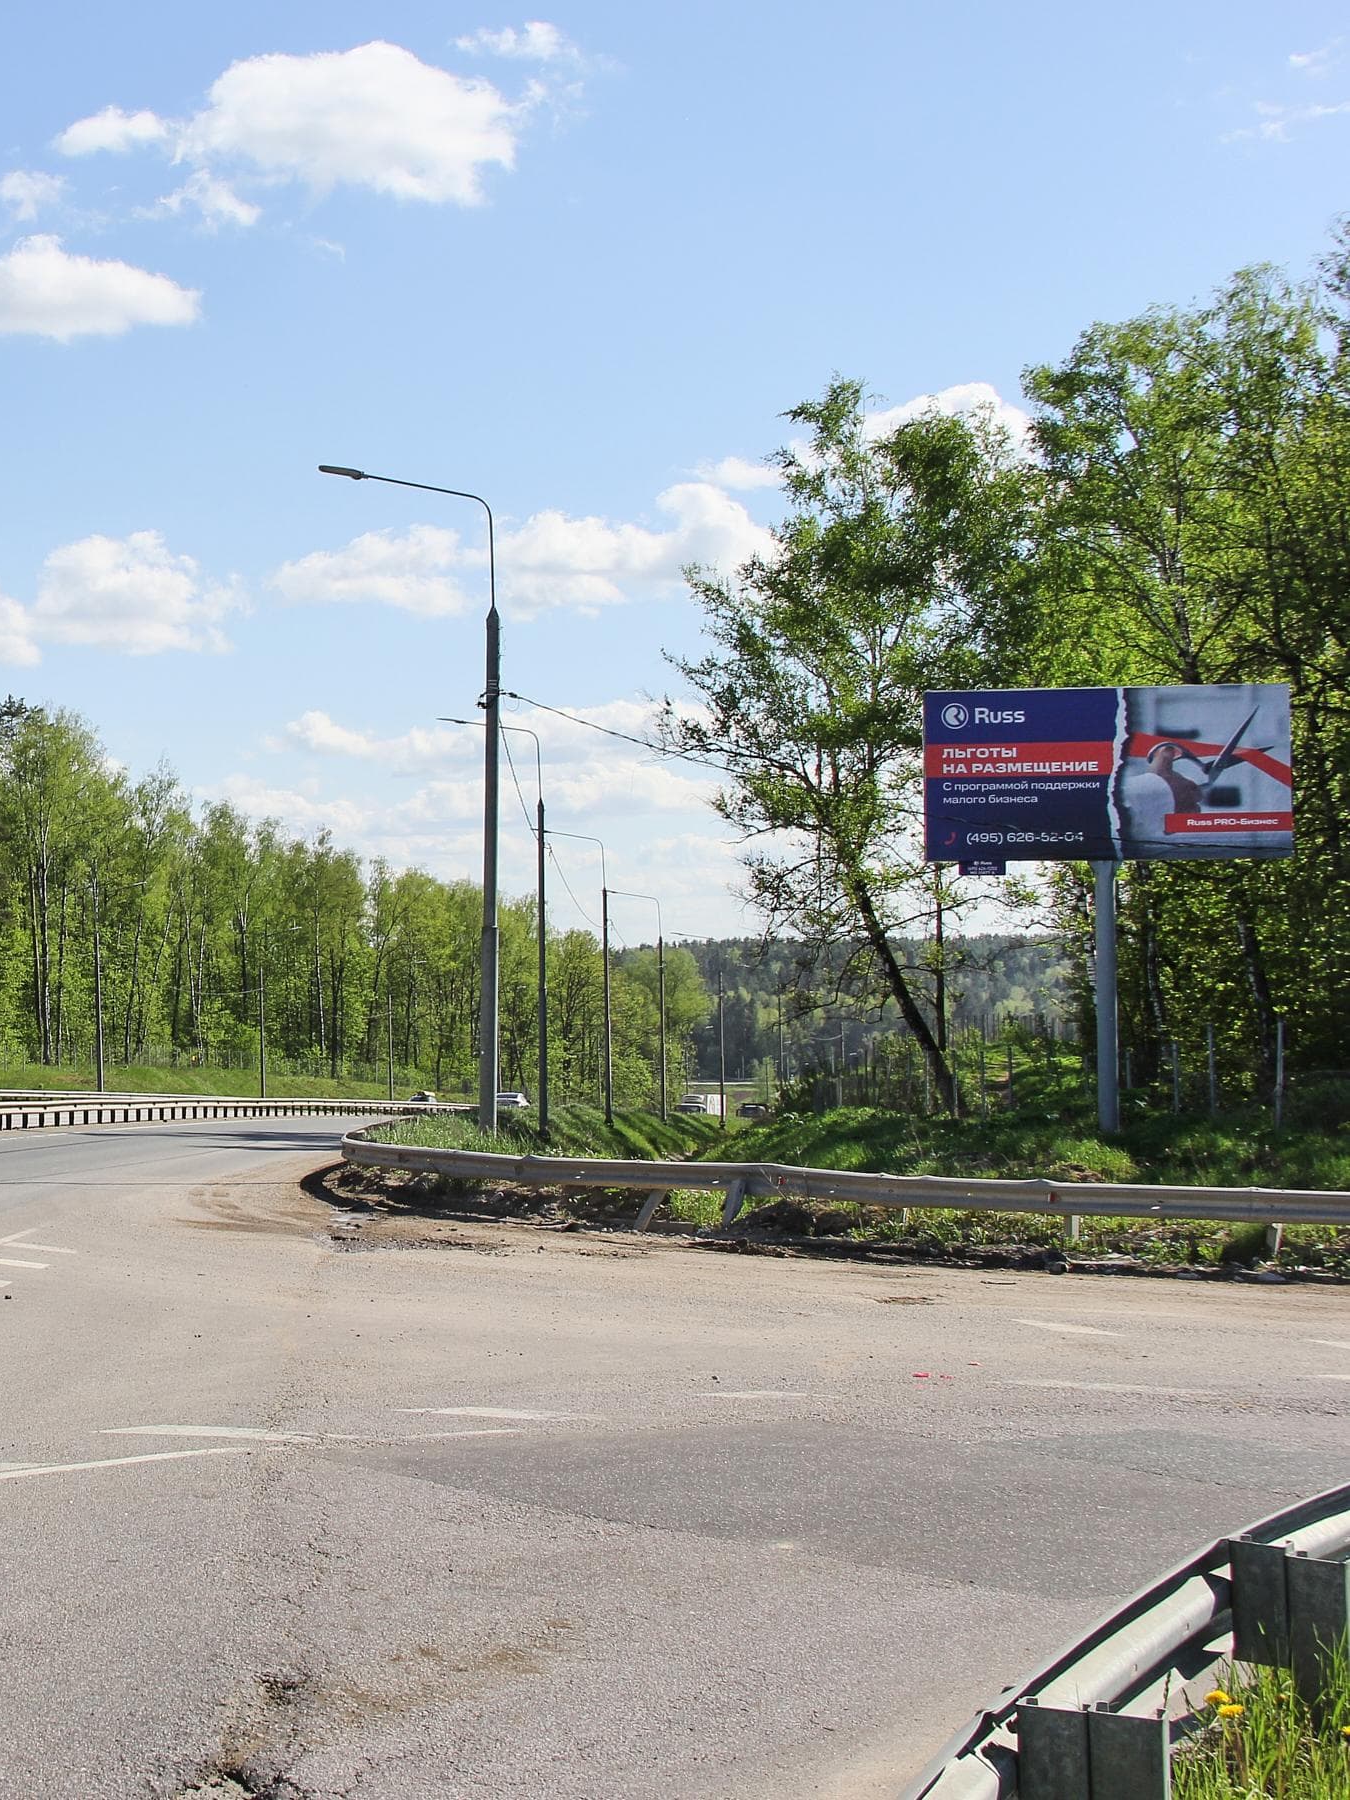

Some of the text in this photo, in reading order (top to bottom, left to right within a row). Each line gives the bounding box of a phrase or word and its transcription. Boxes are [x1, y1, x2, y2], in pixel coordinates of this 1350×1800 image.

[974, 707, 1025, 724] Russ
[942, 747, 1017, 759] ЛЬГОТЫ
[942, 761, 1099, 774] НА РАЗМЕЩЕНИЕ
[942, 780, 1100, 792] С программой поддержки
[942, 794, 1038, 804] малого бизнеса
[1186, 818, 1212, 826] Russ
[966, 831, 1084, 845] (495) 626-52-04
